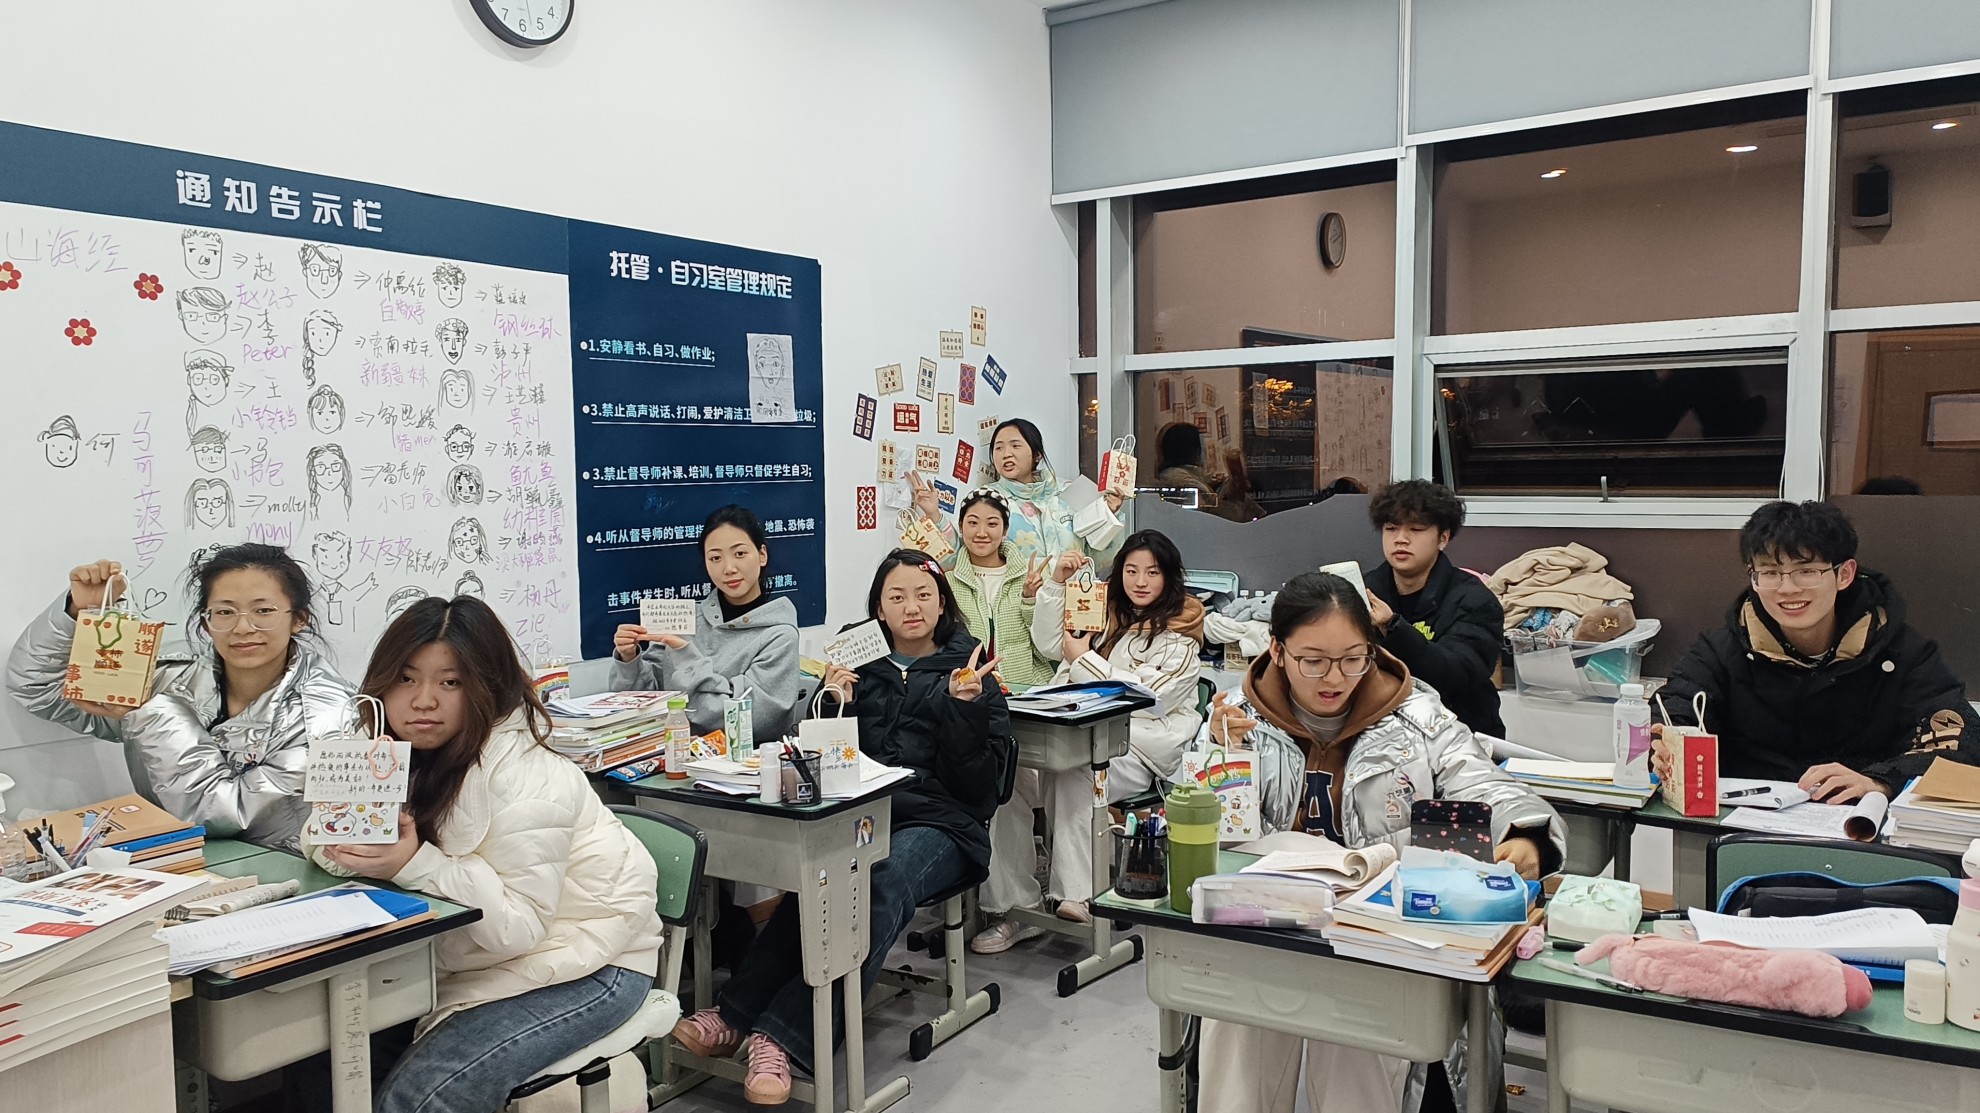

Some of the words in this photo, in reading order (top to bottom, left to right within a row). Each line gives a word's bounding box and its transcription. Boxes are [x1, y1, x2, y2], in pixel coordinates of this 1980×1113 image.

[501, 8, 509, 20] 7
[519, 19, 527, 32] 6
[536, 17, 544, 30] 5
[547, 6, 555, 19] 4
[176, 169, 383, 233] 通知告示栏
[5, 226, 129, 273] 山海经
[253, 253, 277, 282] 赵
[257, 309, 279, 345] 李
[243, 343, 294, 364] Peter
[232, 403, 297, 431] 小铃铛
[232, 458, 284, 486] 小书包
